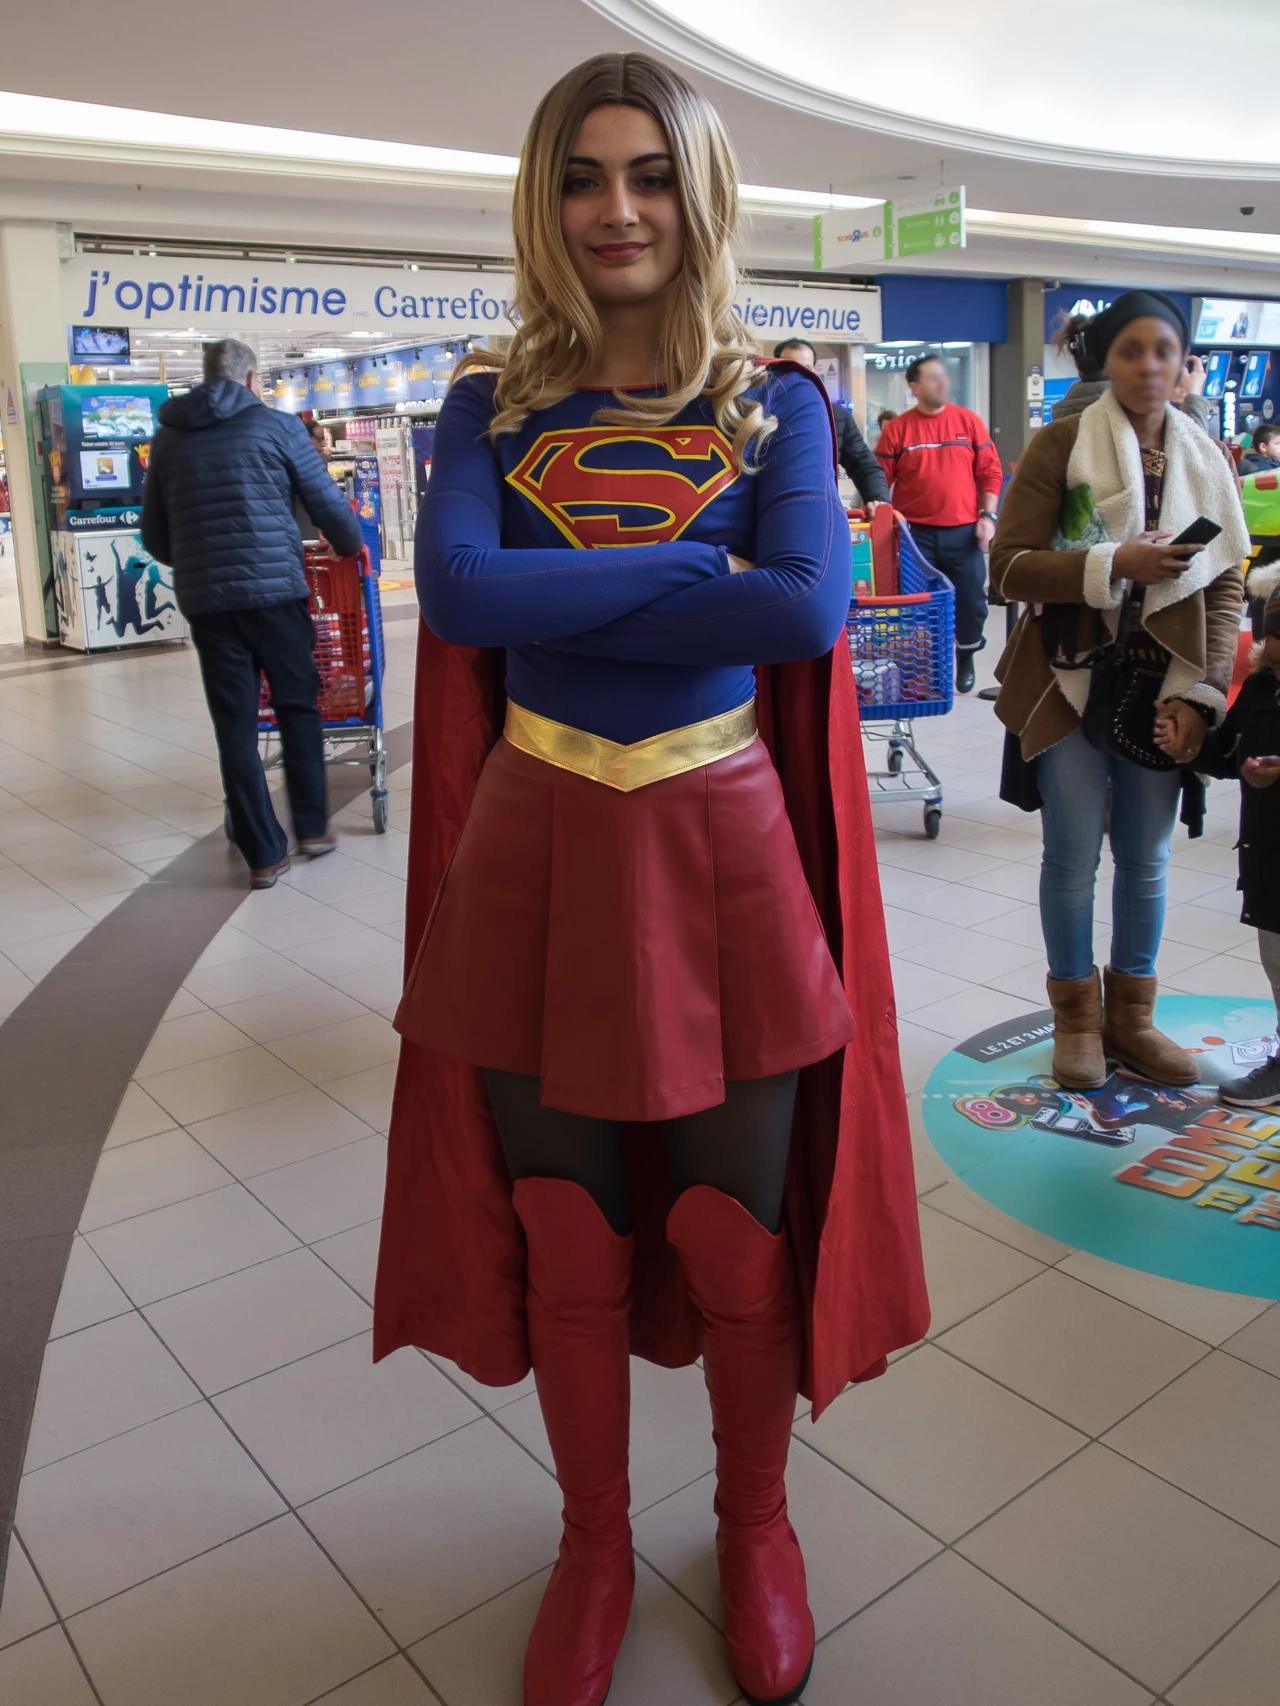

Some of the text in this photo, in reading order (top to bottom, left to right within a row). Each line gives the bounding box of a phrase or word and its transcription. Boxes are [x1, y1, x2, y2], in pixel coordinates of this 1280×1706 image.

[374, 285, 521, 321] Carrefou
[69, 515, 117, 526] Carrefour
[979, 1045, 1002, 1056] LE
[1006, 1035, 1027, 1046] ET
[1031, 1022, 1056, 1037] MA
[1196, 1187, 1252, 1212] TO
